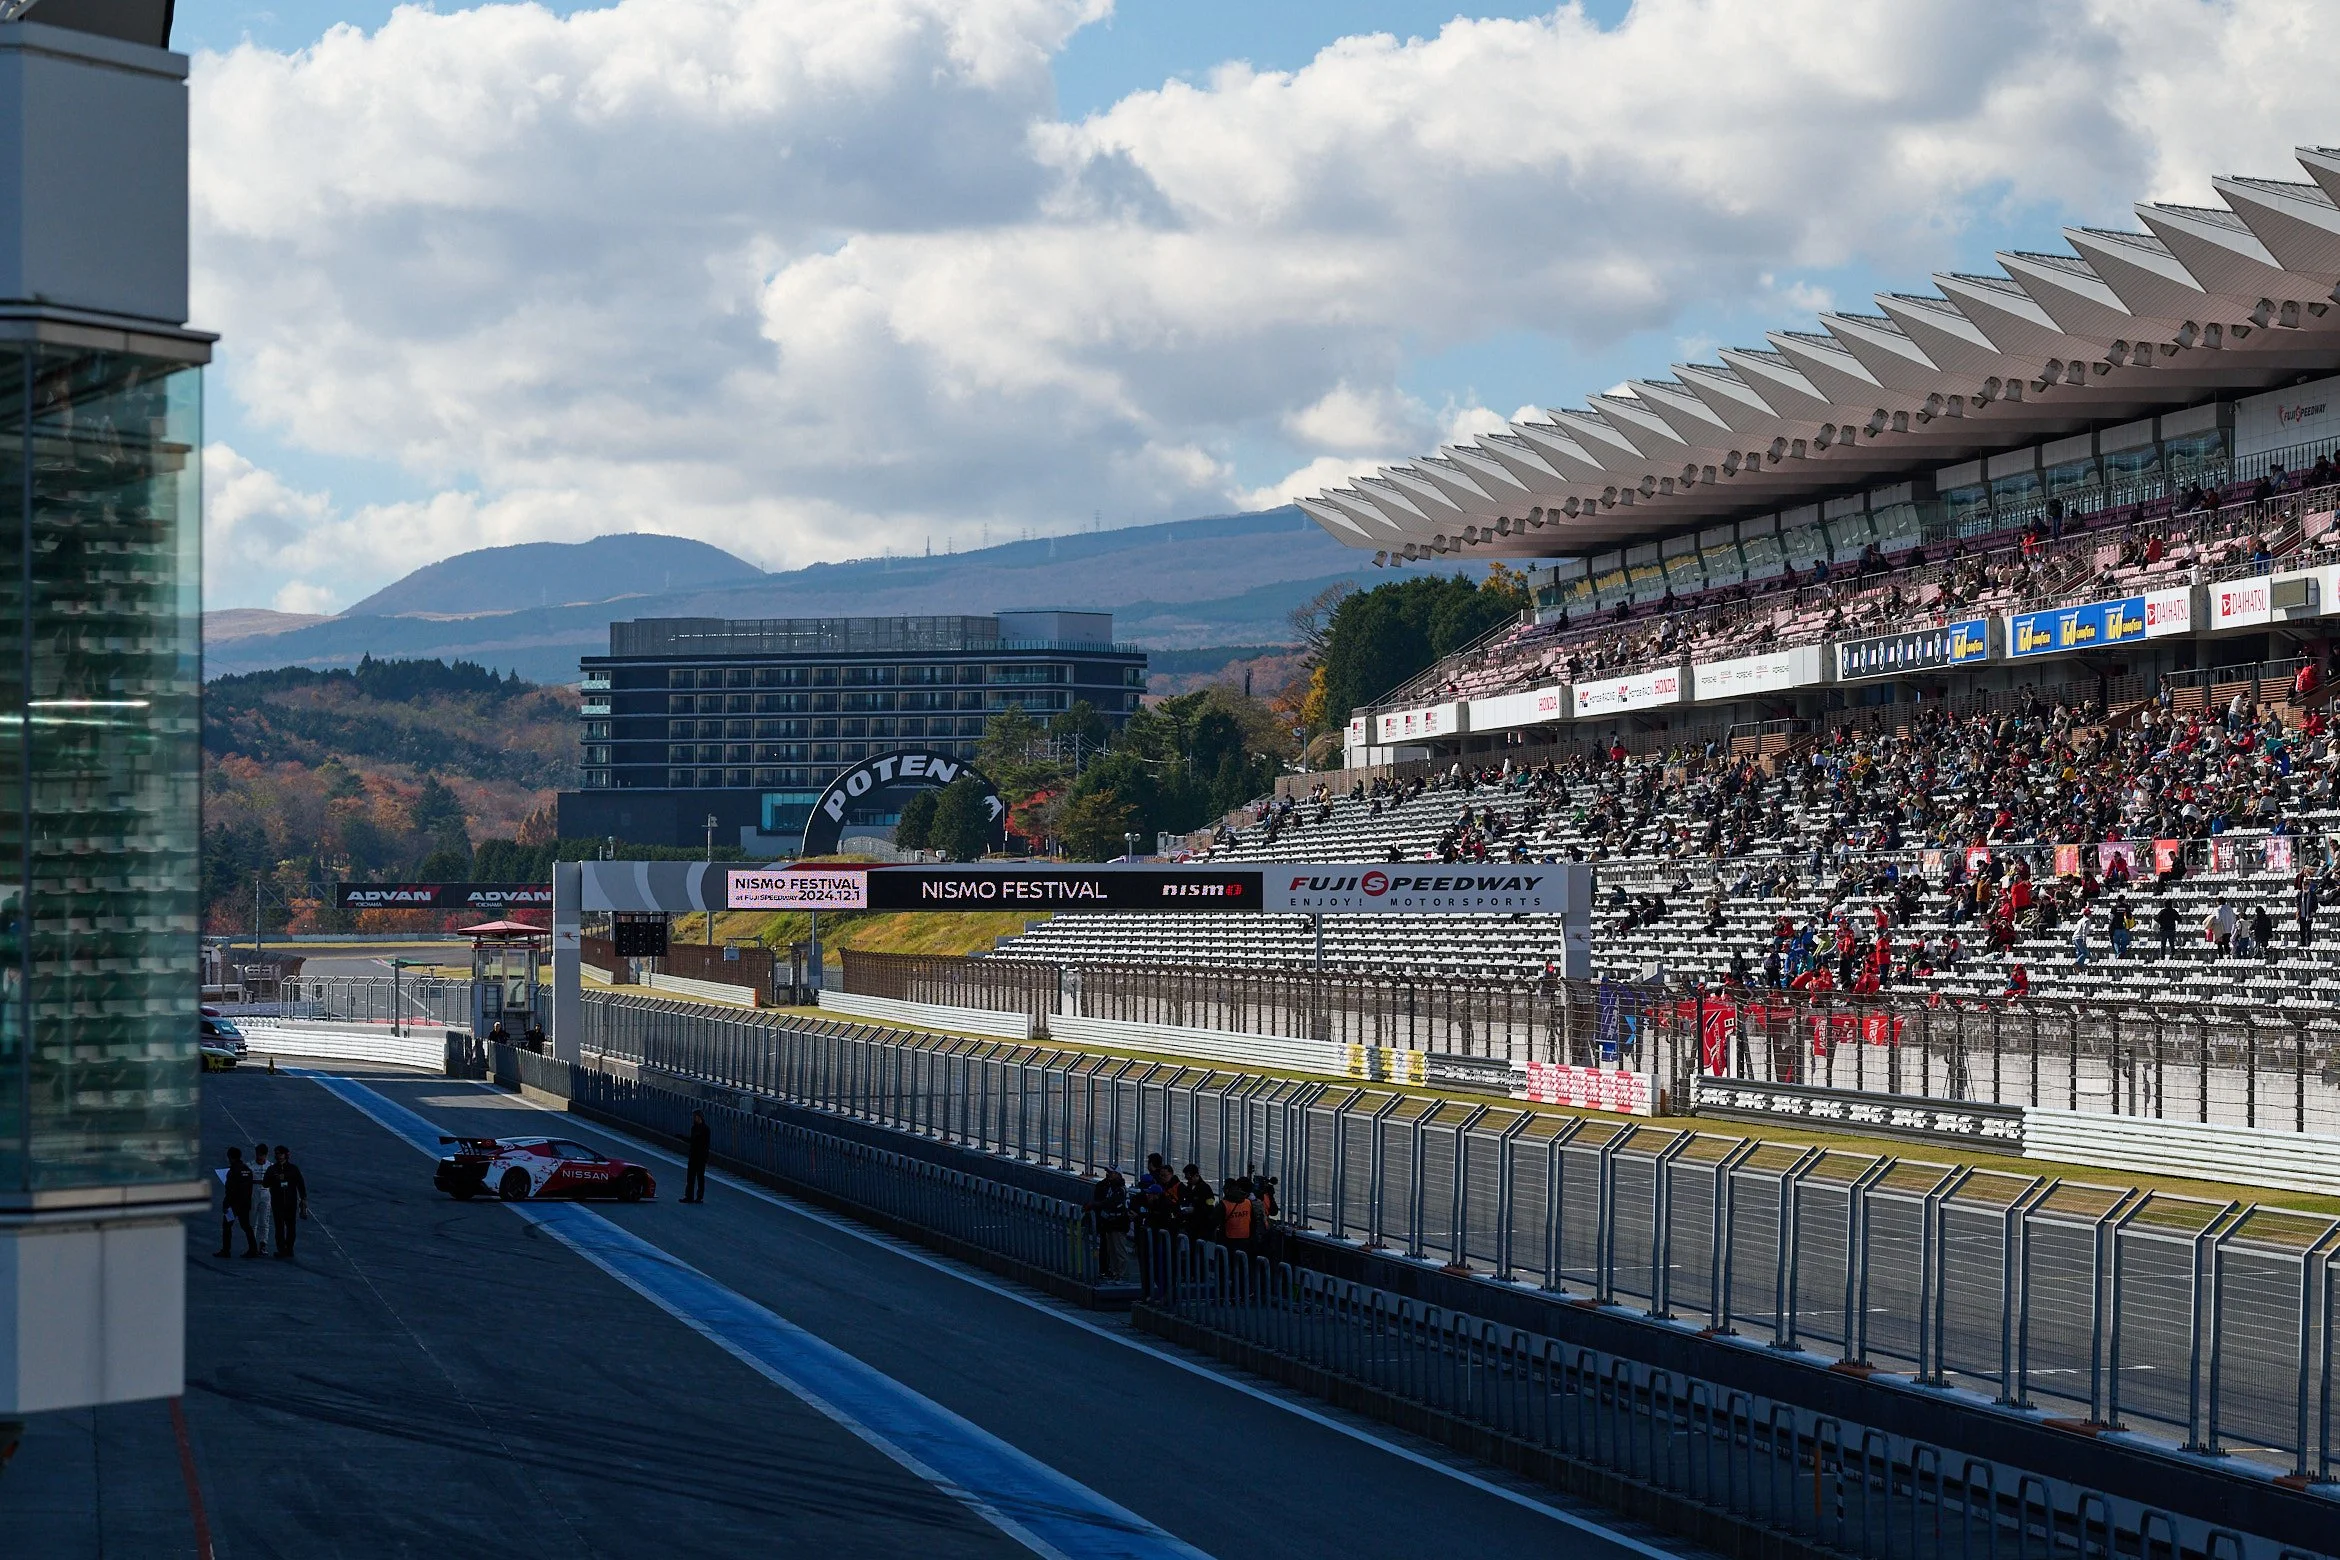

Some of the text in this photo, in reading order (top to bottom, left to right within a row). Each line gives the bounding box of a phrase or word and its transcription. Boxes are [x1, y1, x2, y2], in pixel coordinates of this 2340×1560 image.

[2232, 588, 2266, 614] DAIHATSU
[2156, 599, 2188, 624] DAIHATSU
[1654, 678, 1677, 695] HONDA
[1538, 696, 1558, 711] HONDA
[824, 755, 1003, 822] POTEN
[735, 878, 860, 890] NISMO FESTIVAL
[922, 881, 1108, 899] NISMO FESTIVAL
[1162, 884, 1243, 896] nismo
[1289, 877, 1358, 891] FUJI
[346, 891, 432, 901] ADVAN
[467, 891, 552, 901] ADVAN
[798, 890, 860, 901] 2024.12.1
[1290, 898, 1541, 906] ENJOY! MOTORSPORTS
[562, 1169, 609, 1181] NISSAN
